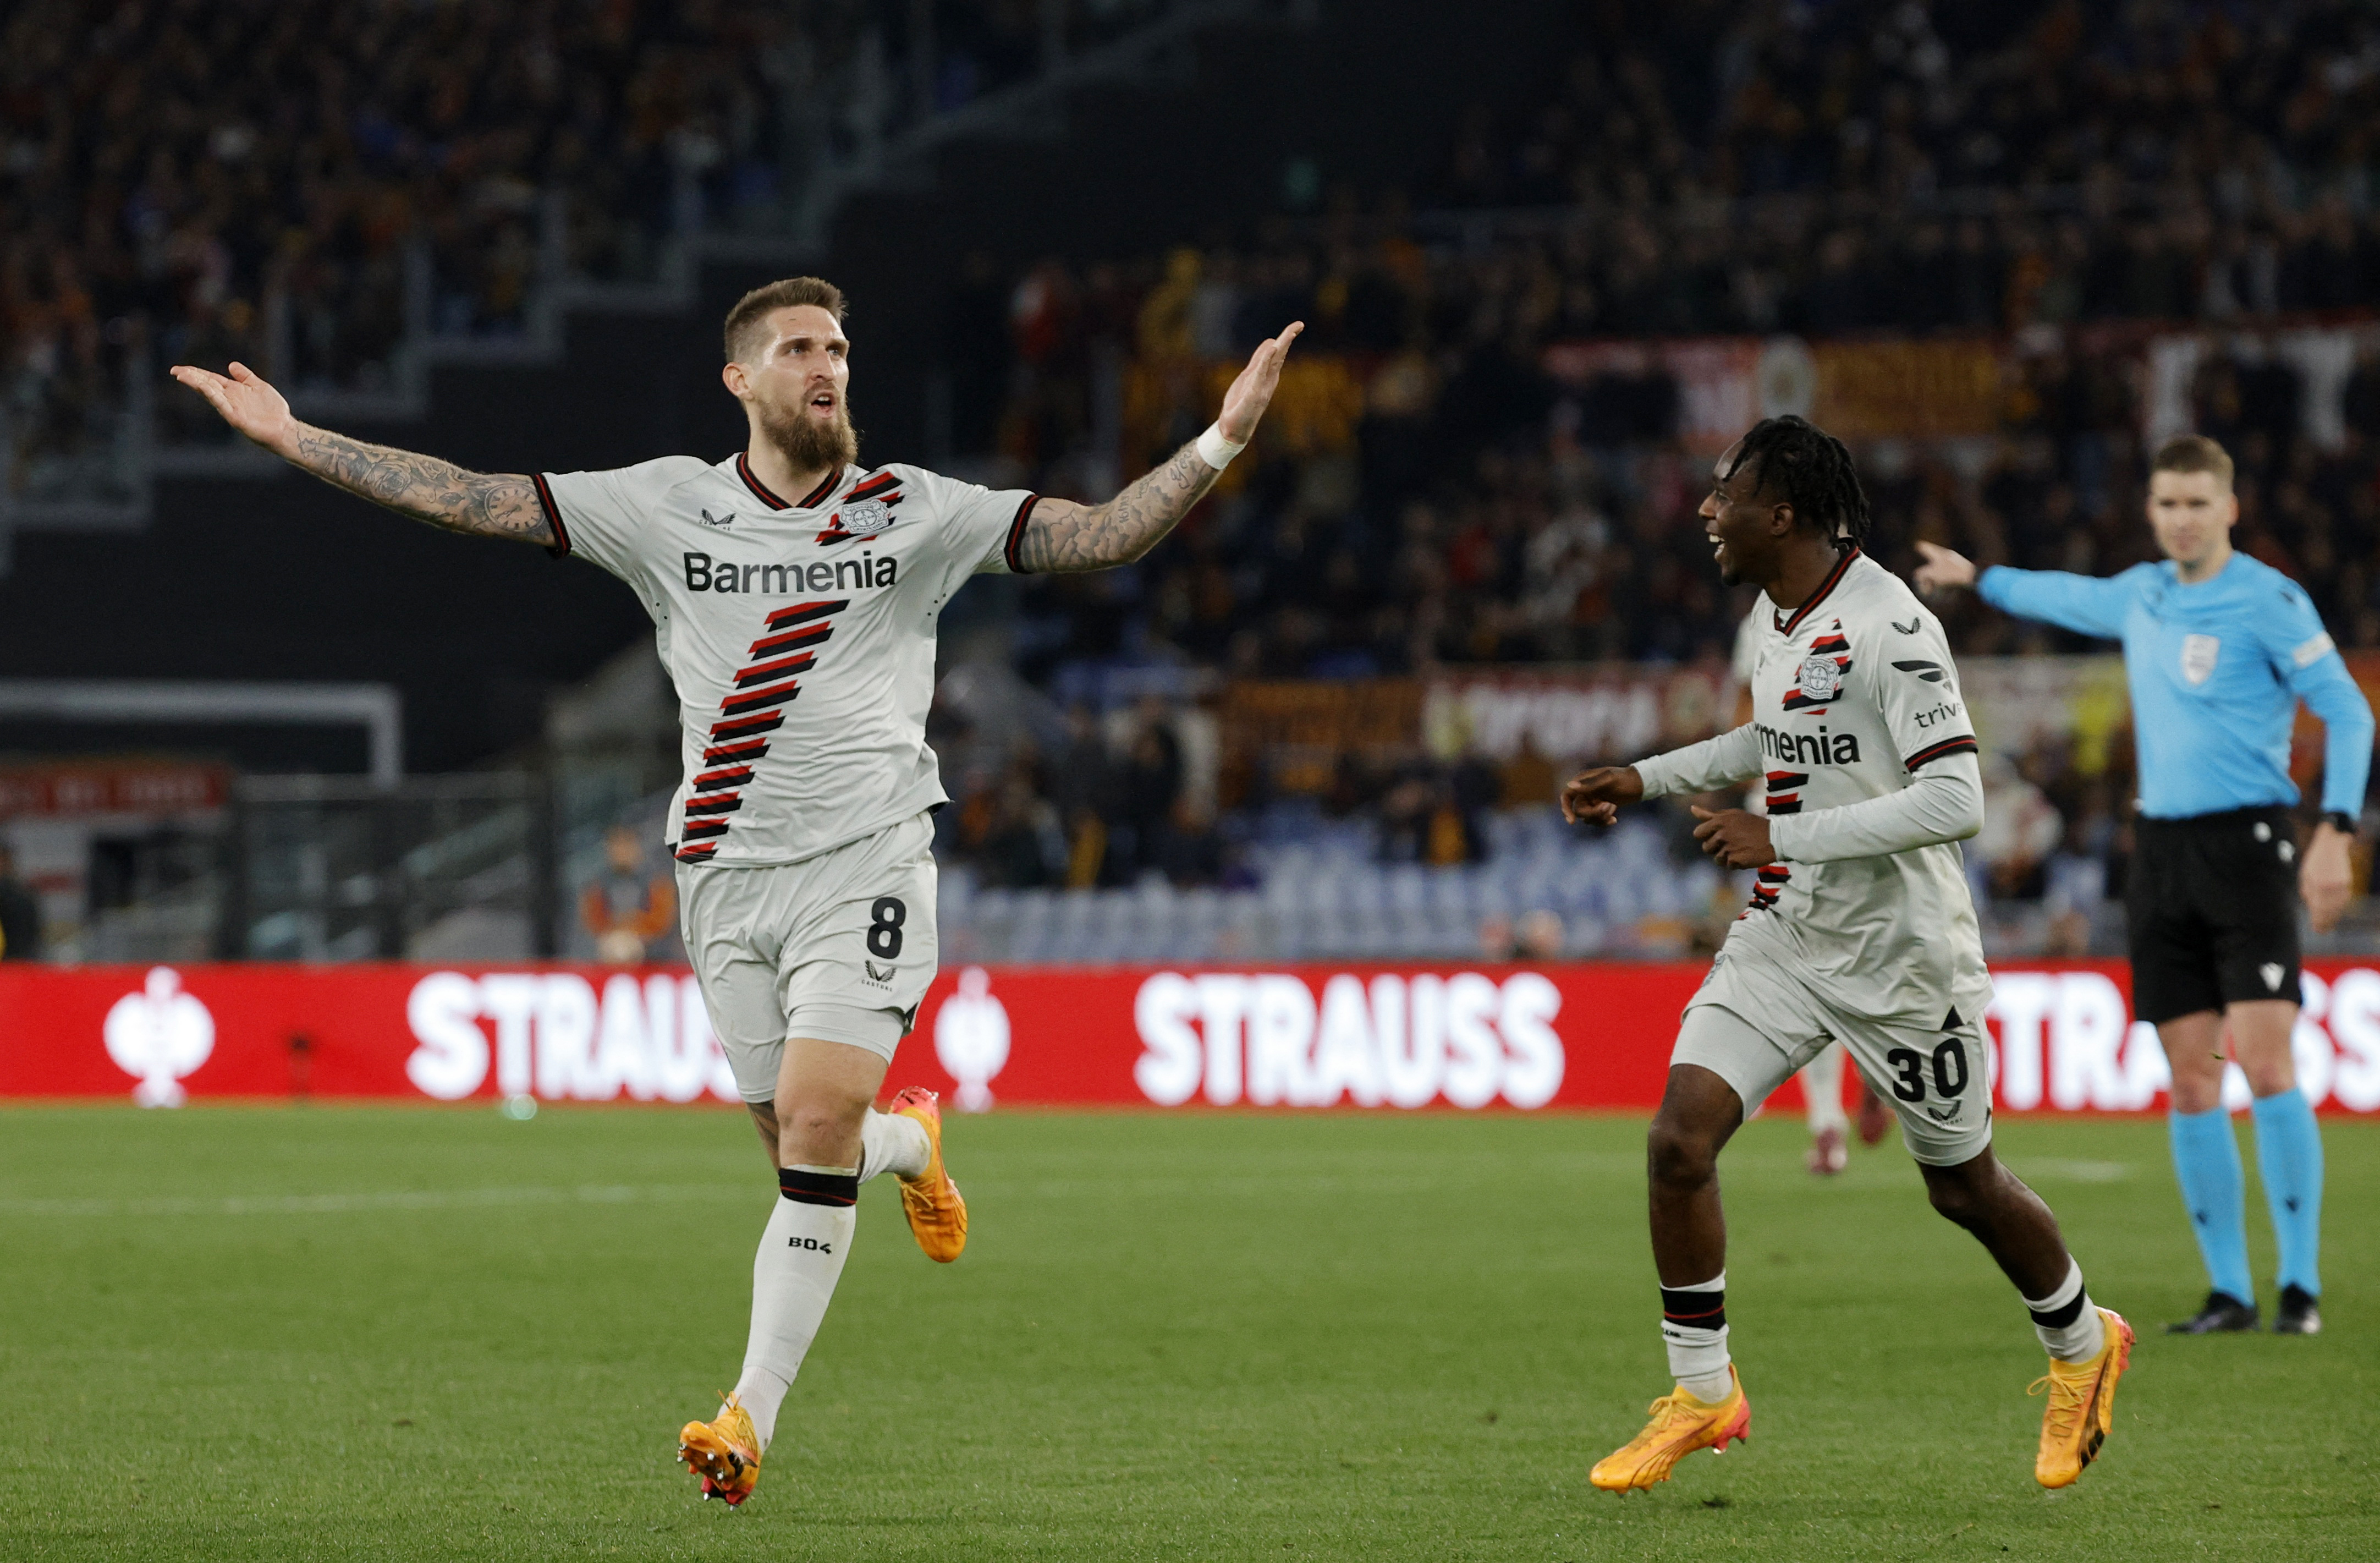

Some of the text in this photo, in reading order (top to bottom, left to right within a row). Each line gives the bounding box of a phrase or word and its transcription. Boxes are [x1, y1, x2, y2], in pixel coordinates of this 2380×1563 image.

[683, 550, 898, 594] Barmenia
[1914, 702, 1962, 728] triv
[1755, 723, 1862, 765] menia
[867, 896, 906, 959] 8
[405, 970, 744, 1103] STRAU
[1133, 971, 1566, 1109] STRAUSS
[1887, 1037, 1969, 1103] 30
[788, 1237, 832, 1255] B04
